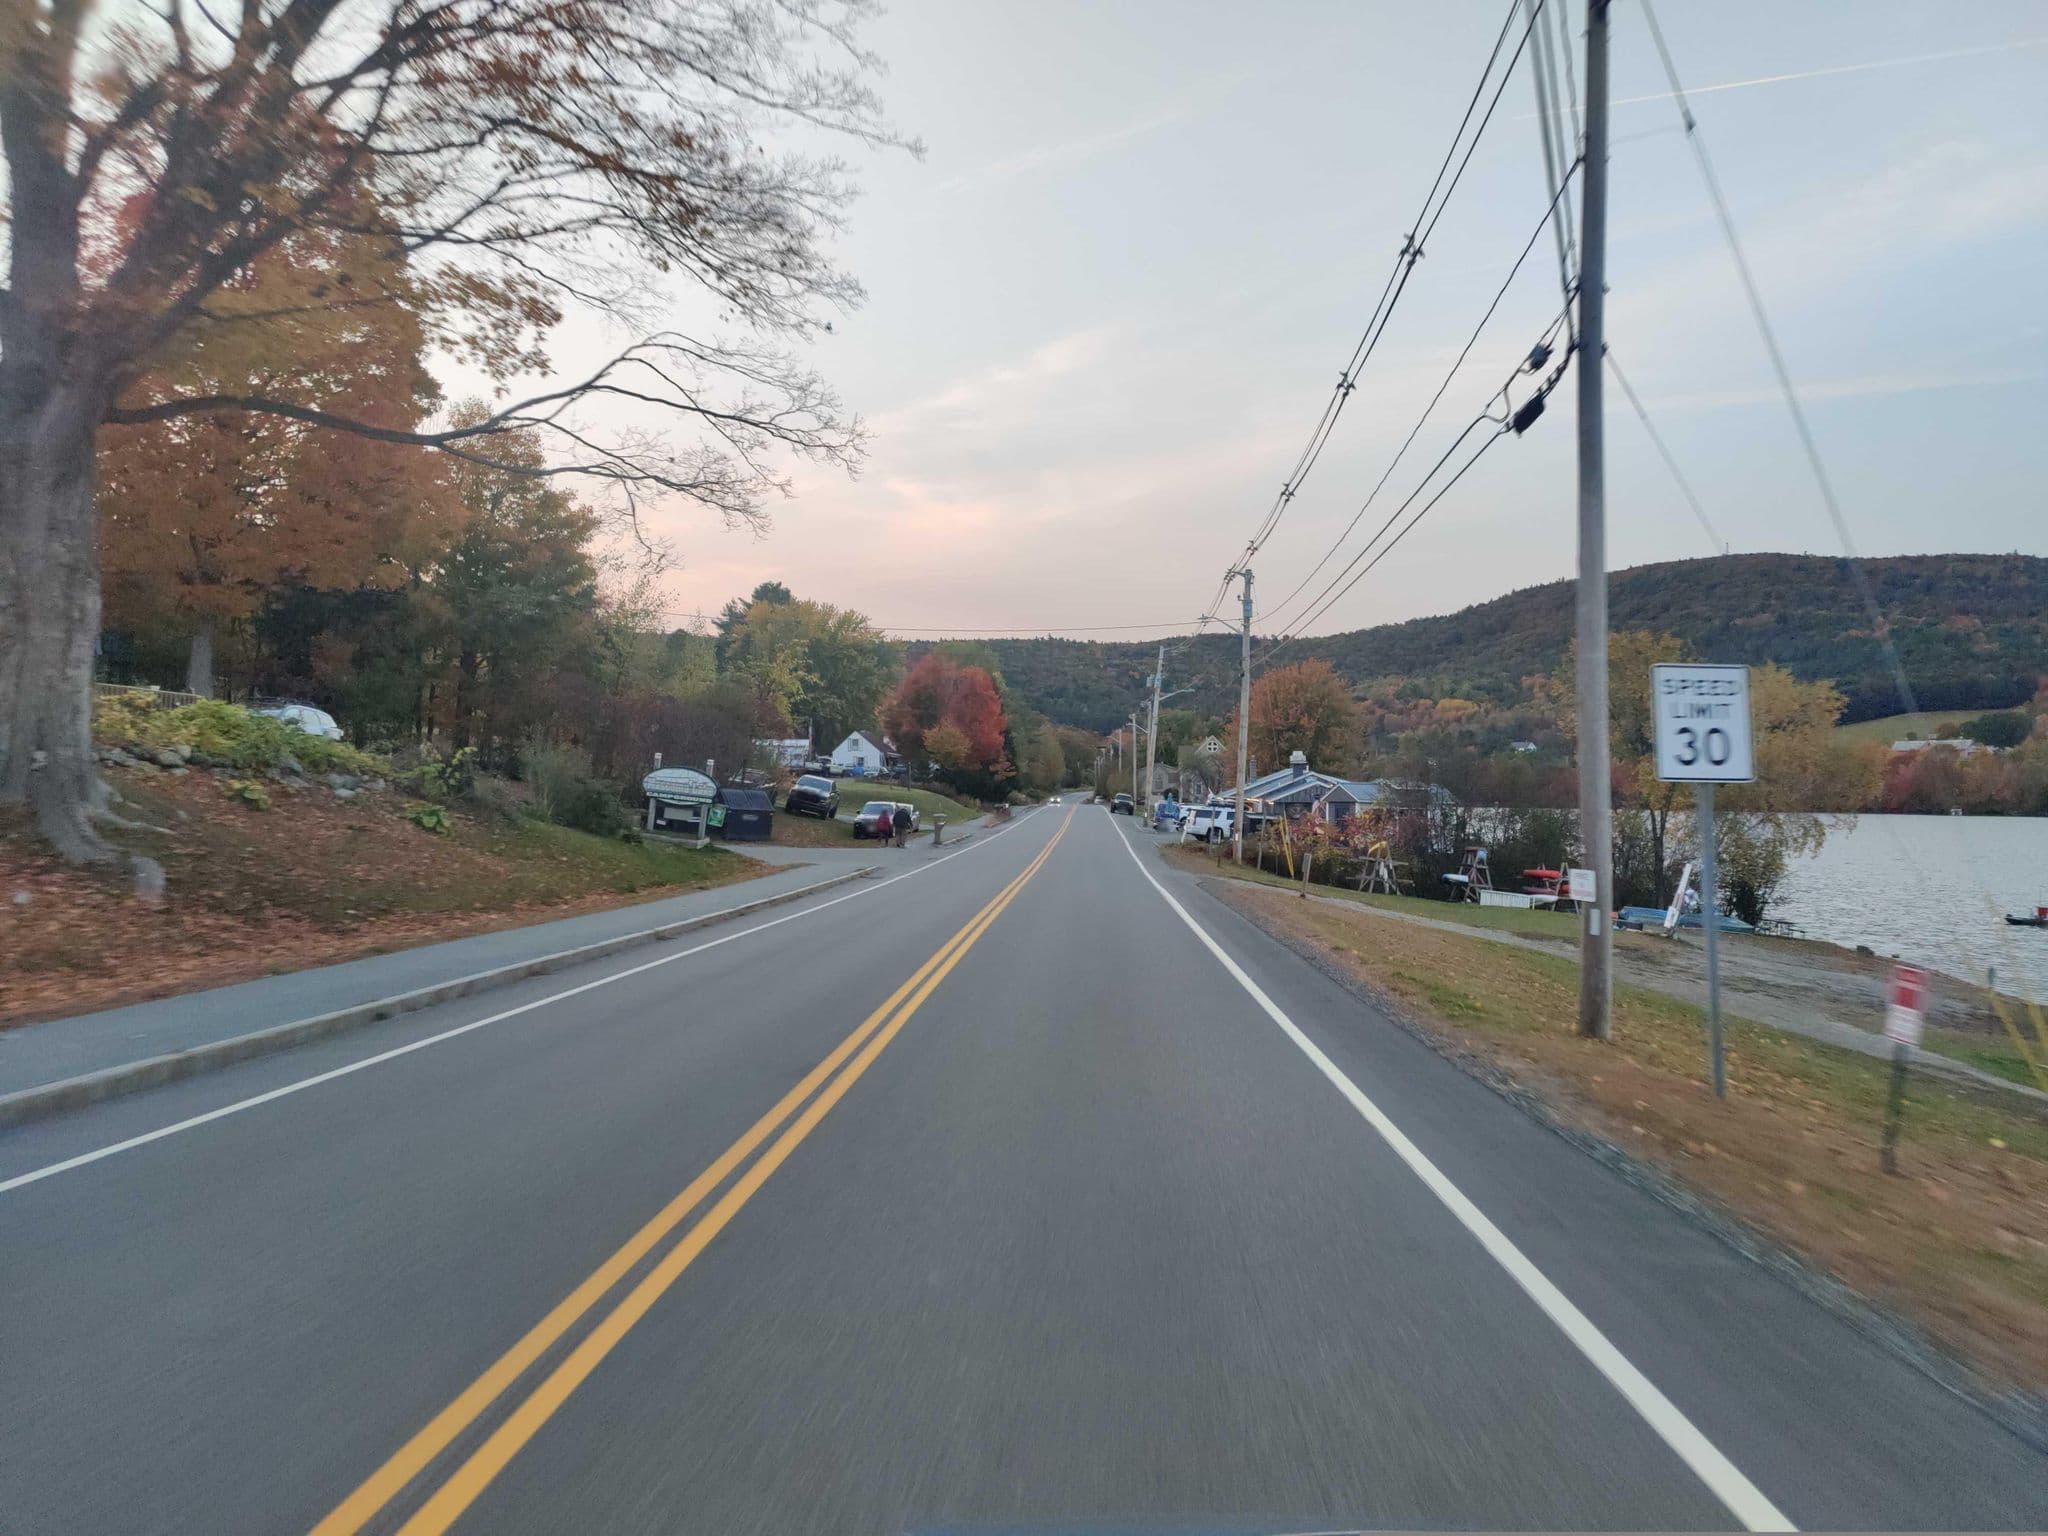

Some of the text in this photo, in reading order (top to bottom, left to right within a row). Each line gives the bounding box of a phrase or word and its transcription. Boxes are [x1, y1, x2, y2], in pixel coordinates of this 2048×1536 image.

[1662, 678, 1740, 696] SPEED
[1670, 703, 1734, 719] LIMIT
[1673, 727, 1731, 766] 30
